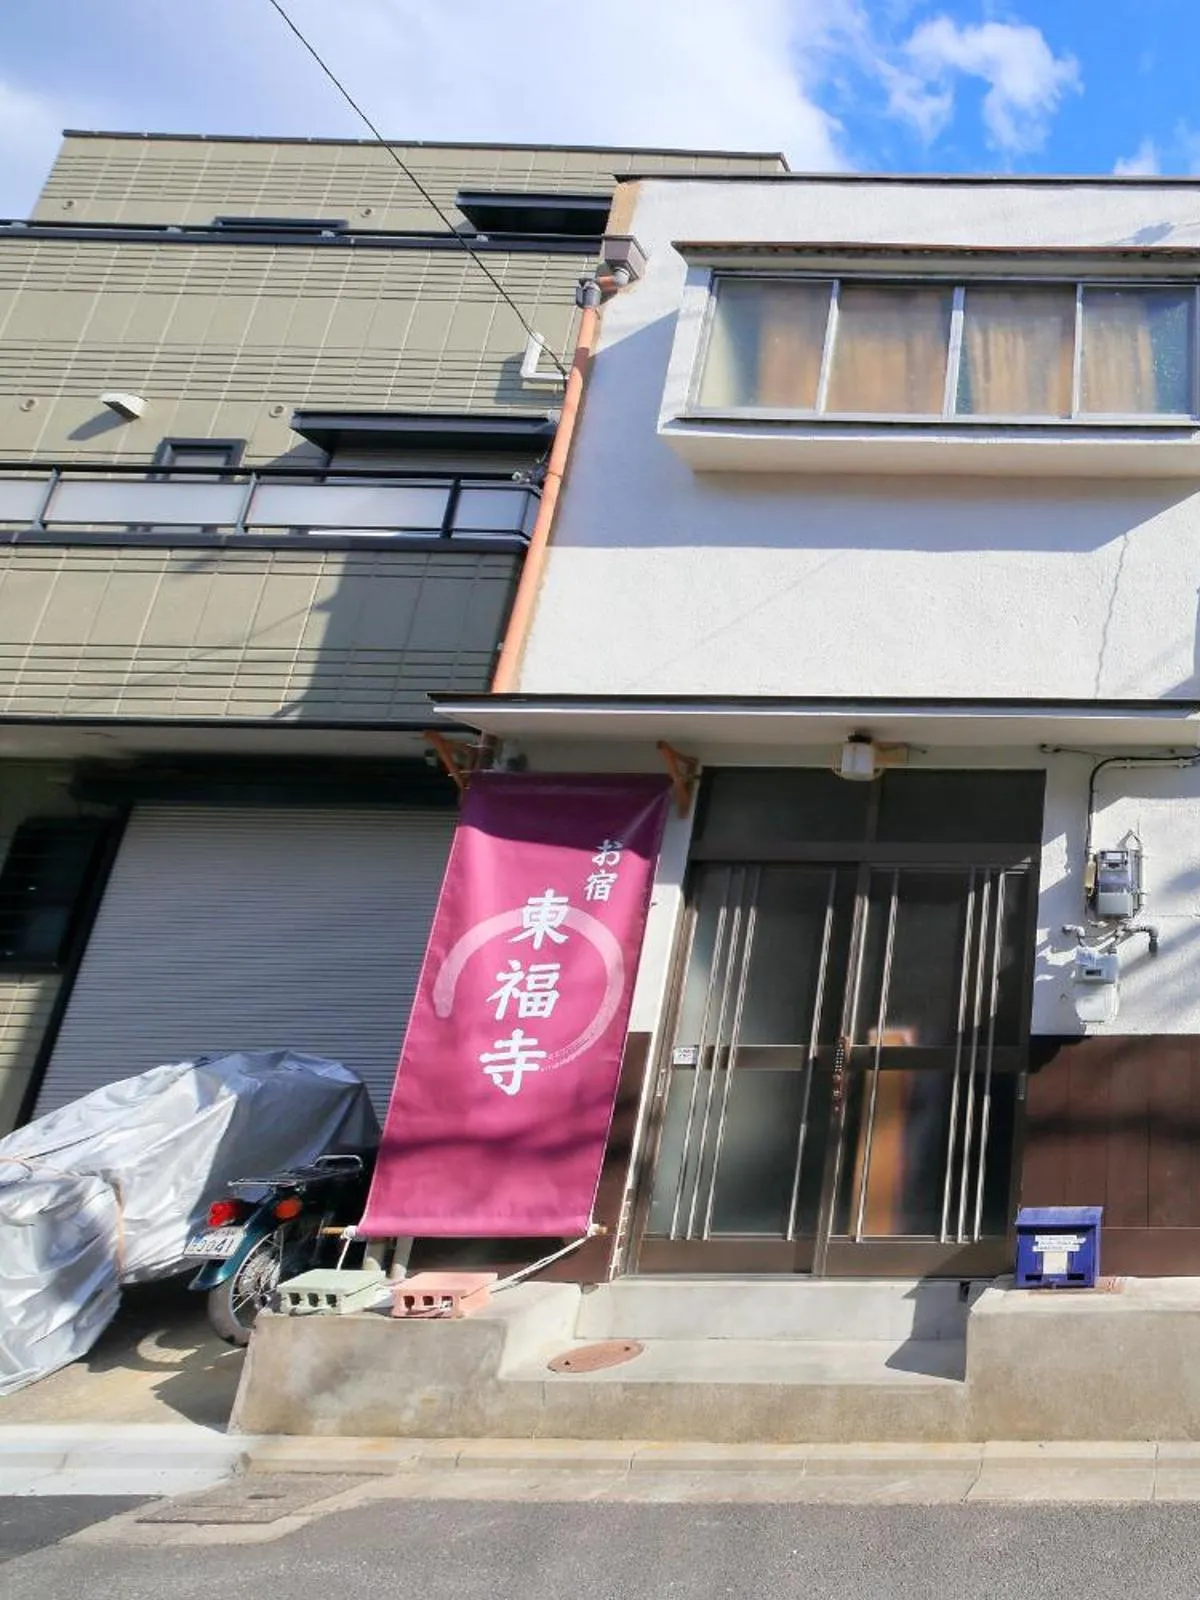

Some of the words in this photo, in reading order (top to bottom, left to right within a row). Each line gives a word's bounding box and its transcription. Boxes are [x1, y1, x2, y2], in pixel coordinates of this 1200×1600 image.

[584, 839, 623, 901] お宿
[480, 888, 570, 1096] 東福寺
